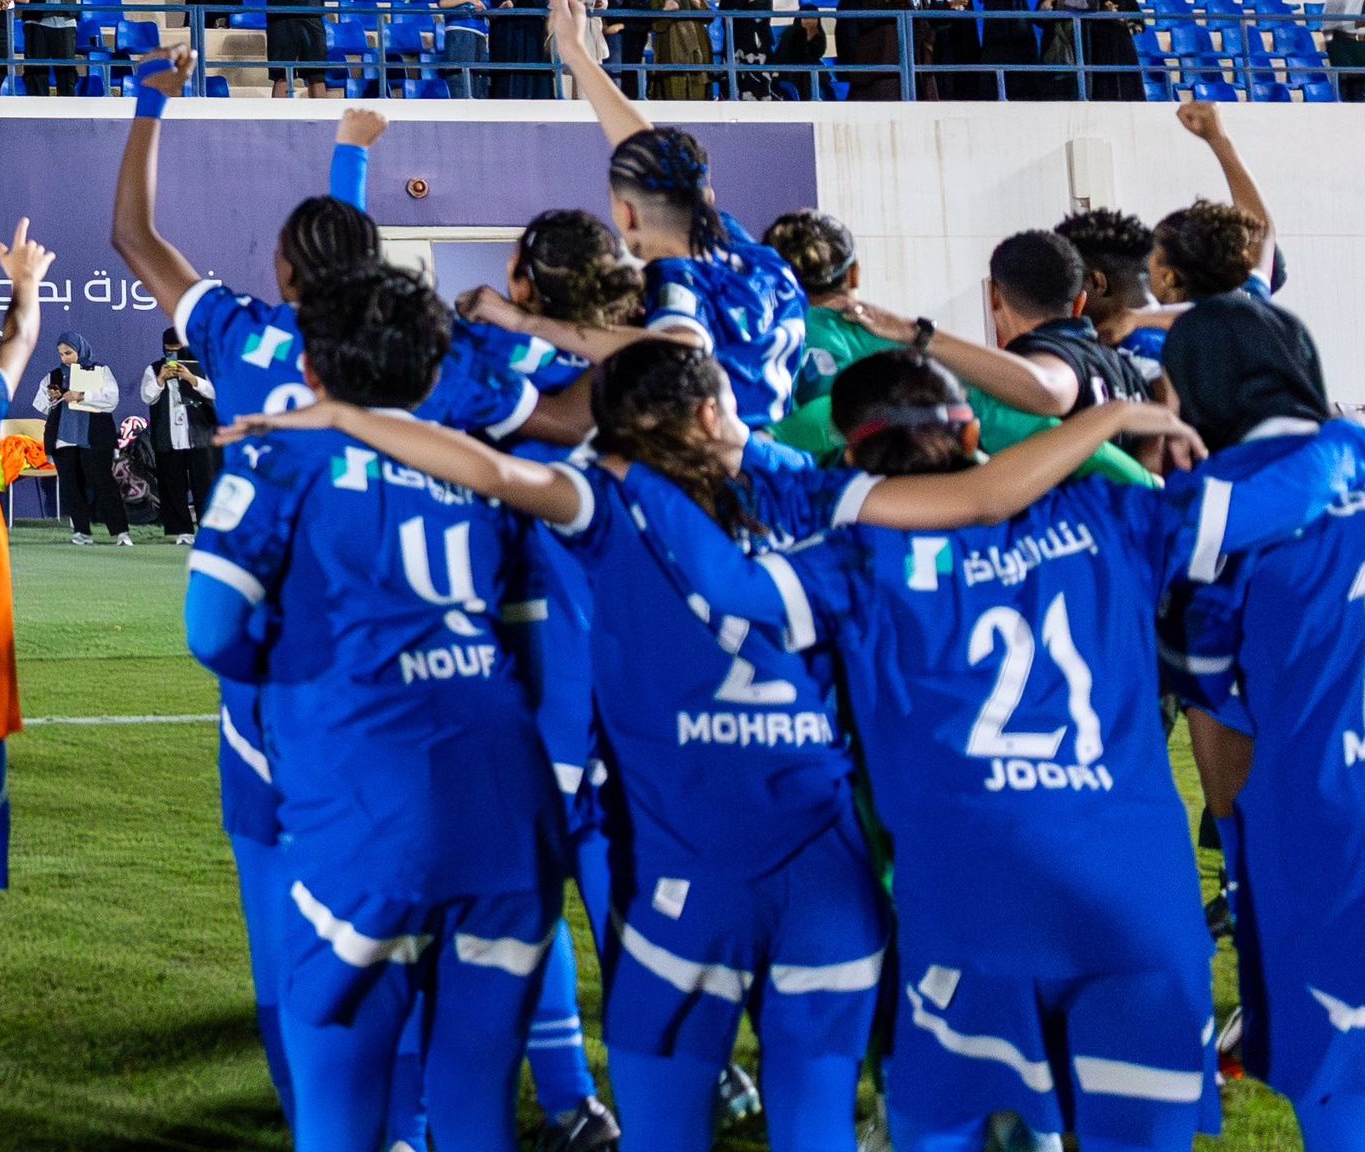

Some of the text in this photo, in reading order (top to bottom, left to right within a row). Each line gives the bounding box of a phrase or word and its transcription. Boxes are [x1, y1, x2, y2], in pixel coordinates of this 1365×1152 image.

[399, 515, 487, 637] 4
[400, 644, 497, 685] NOUF
[687, 593, 798, 705] 2
[965, 591, 1104, 766] 21
